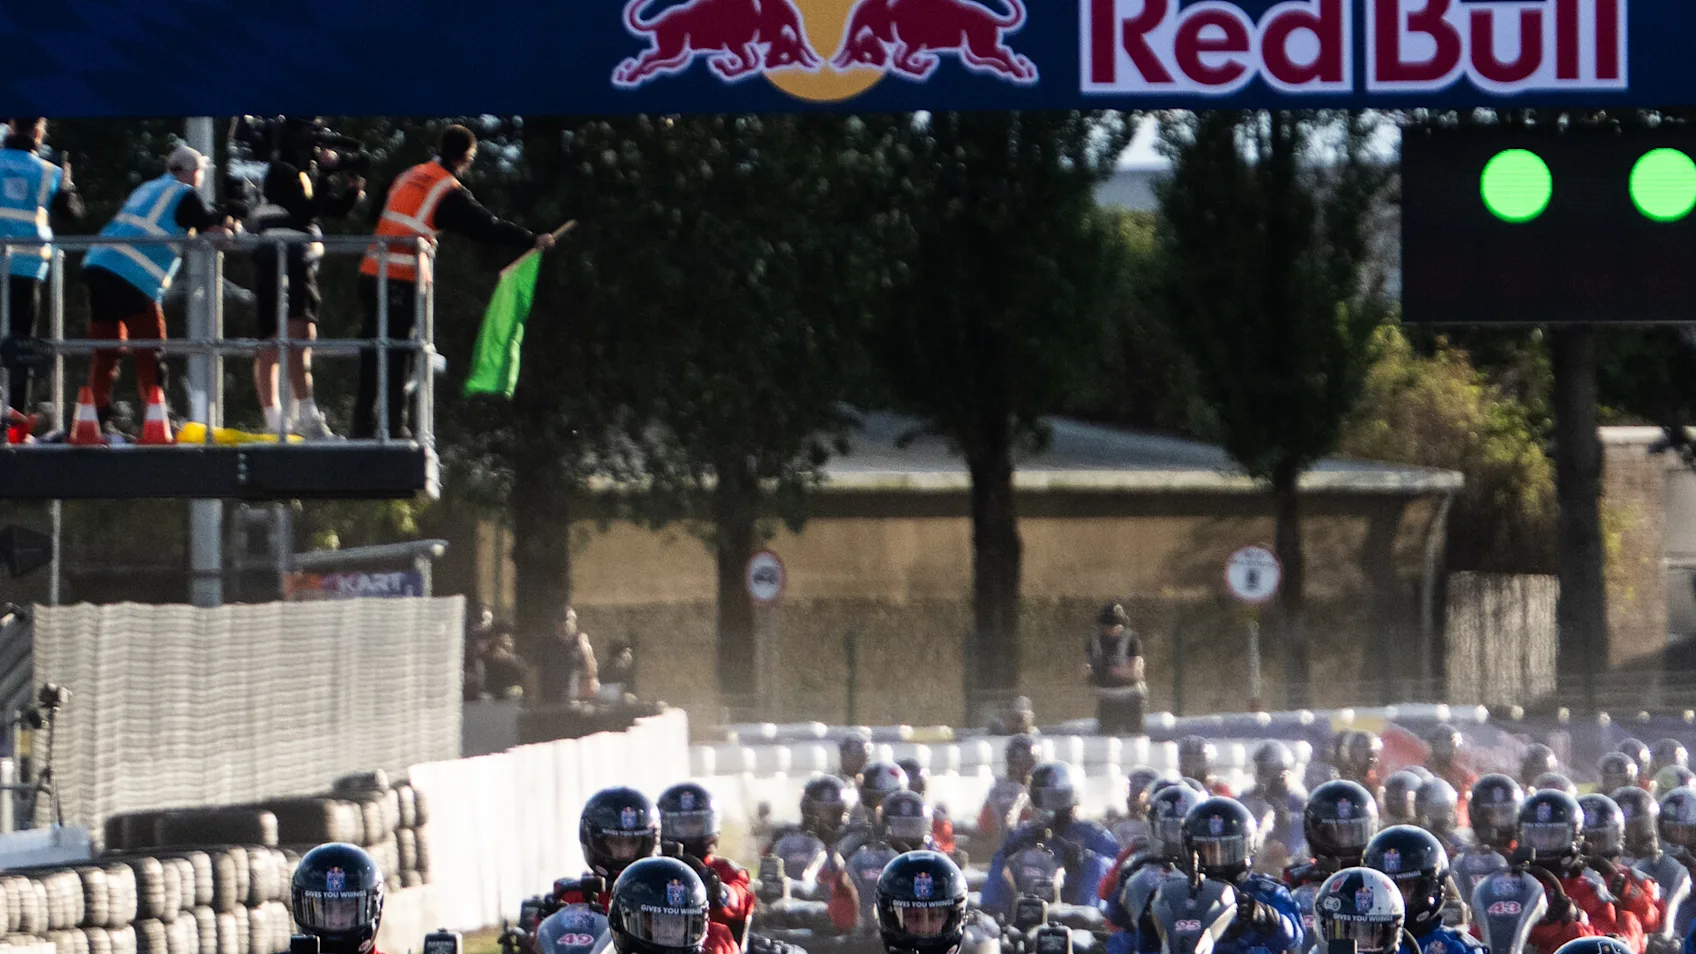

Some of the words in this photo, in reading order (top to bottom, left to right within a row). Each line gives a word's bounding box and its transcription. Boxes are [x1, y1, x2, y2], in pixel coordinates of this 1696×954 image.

[1085, 0, 1347, 88] Red
[1370, 0, 1622, 88] Bull
[304, 890, 321, 898] GIVES
[323, 891, 338, 899] YOU
[640, 903, 661, 913] GIVES
[663, 906, 678, 915] YOU
[892, 899, 910, 907] GIVES
[1487, 901, 1522, 916] 43
[1333, 913, 1351, 921] GIVES
[557, 932, 594, 947] 49
